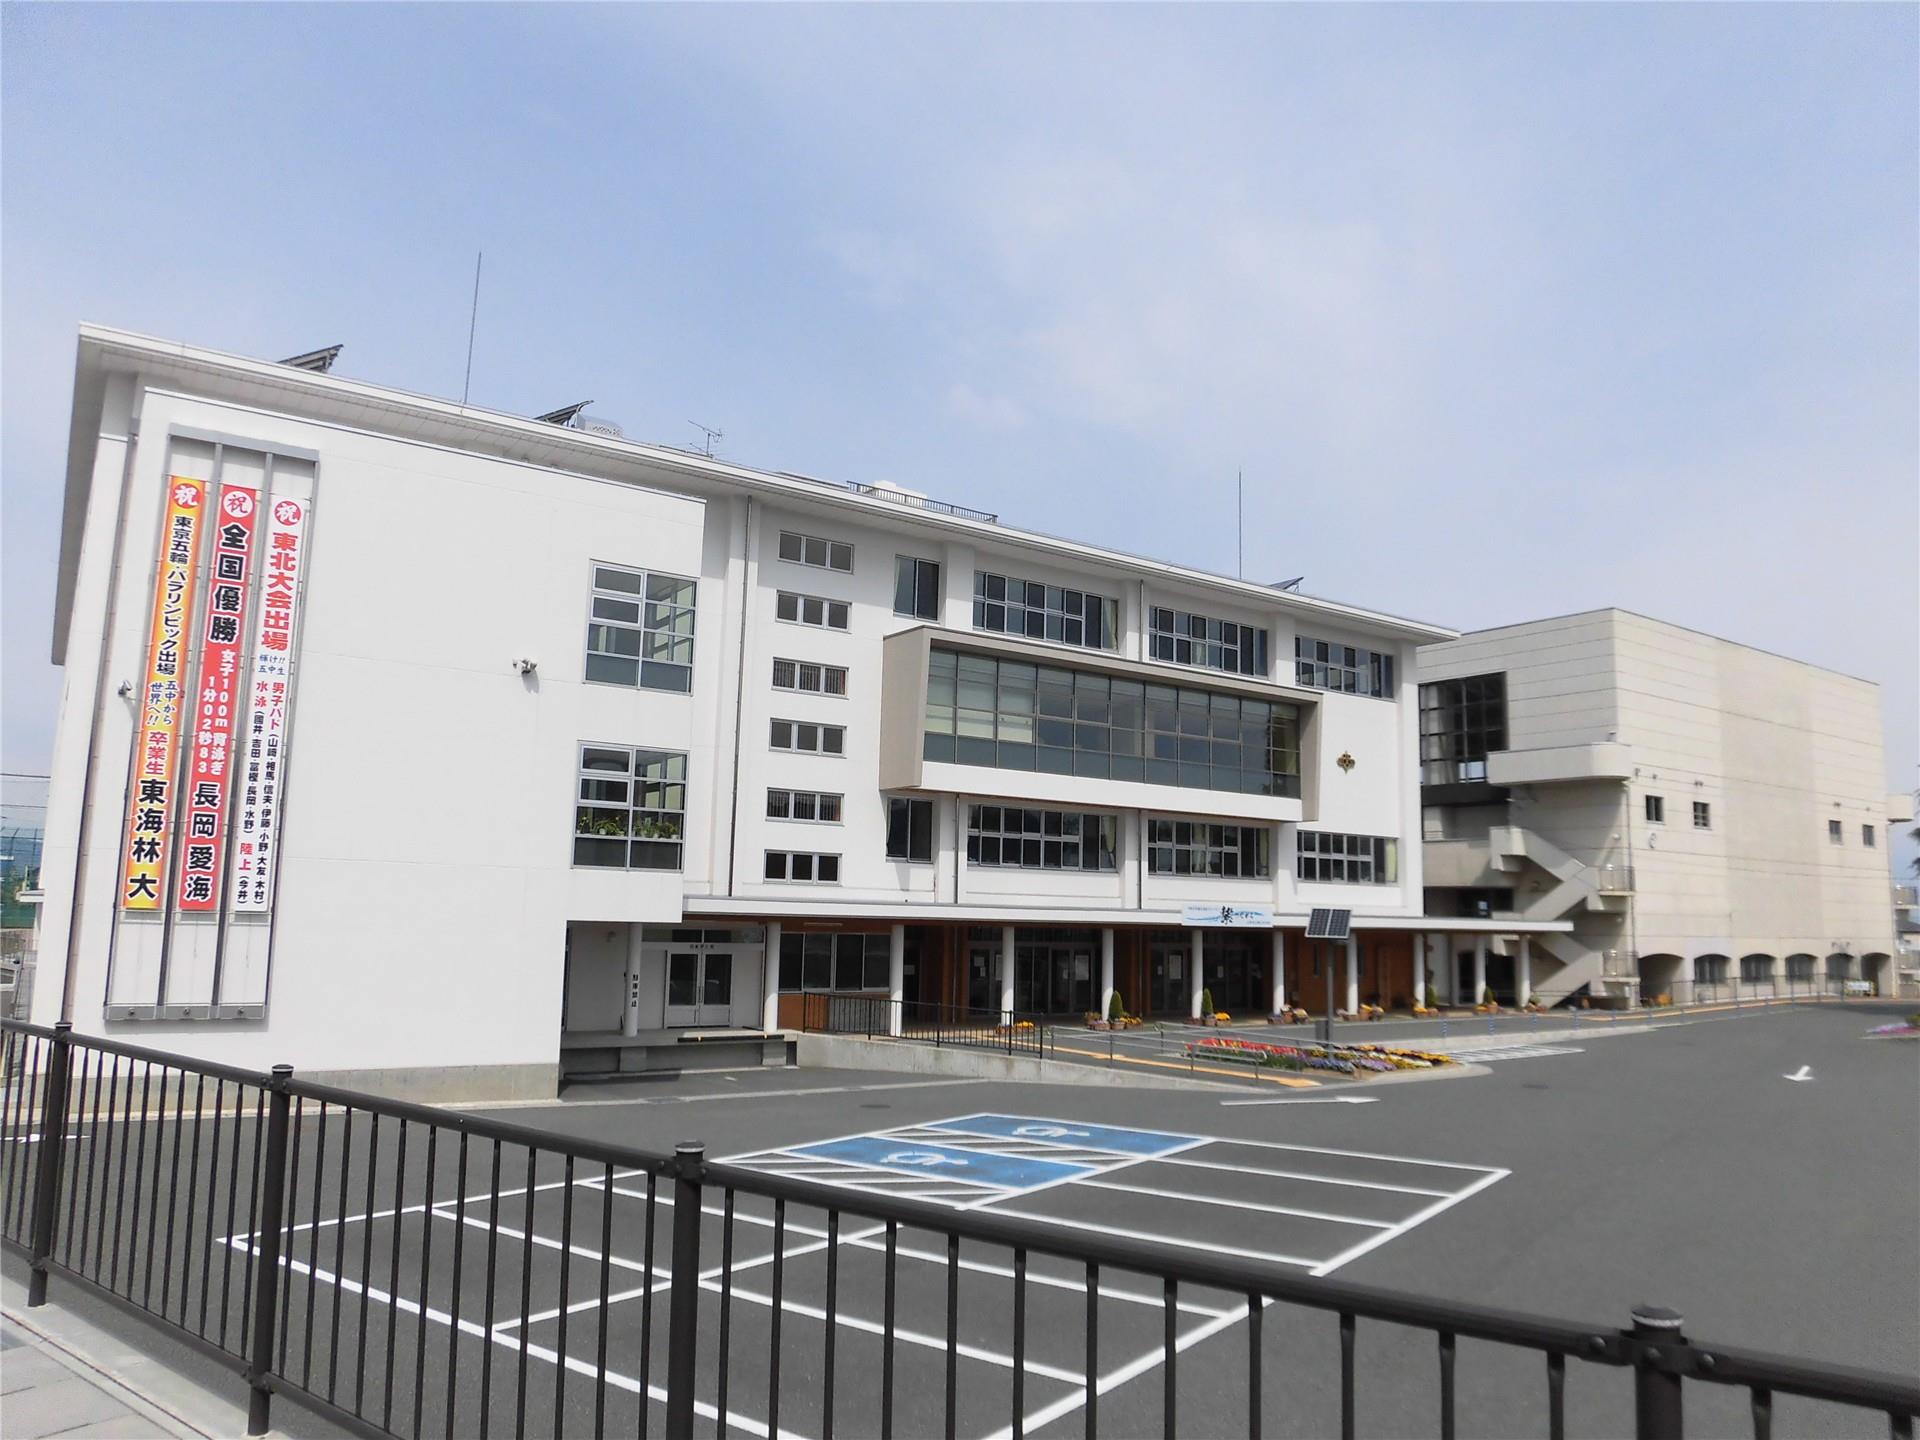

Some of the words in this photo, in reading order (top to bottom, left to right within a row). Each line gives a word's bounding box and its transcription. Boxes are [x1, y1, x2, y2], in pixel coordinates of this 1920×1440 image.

[174, 484, 199, 506] 祝
[227, 494, 249, 514] 祝
[275, 501, 300, 524] 祝
[210, 524, 247, 642] 全国優勝
[261, 532, 298, 651] 東北大会出場
[145, 731, 168, 775] 卒業生
[186, 783, 219, 901] 長岡愛海
